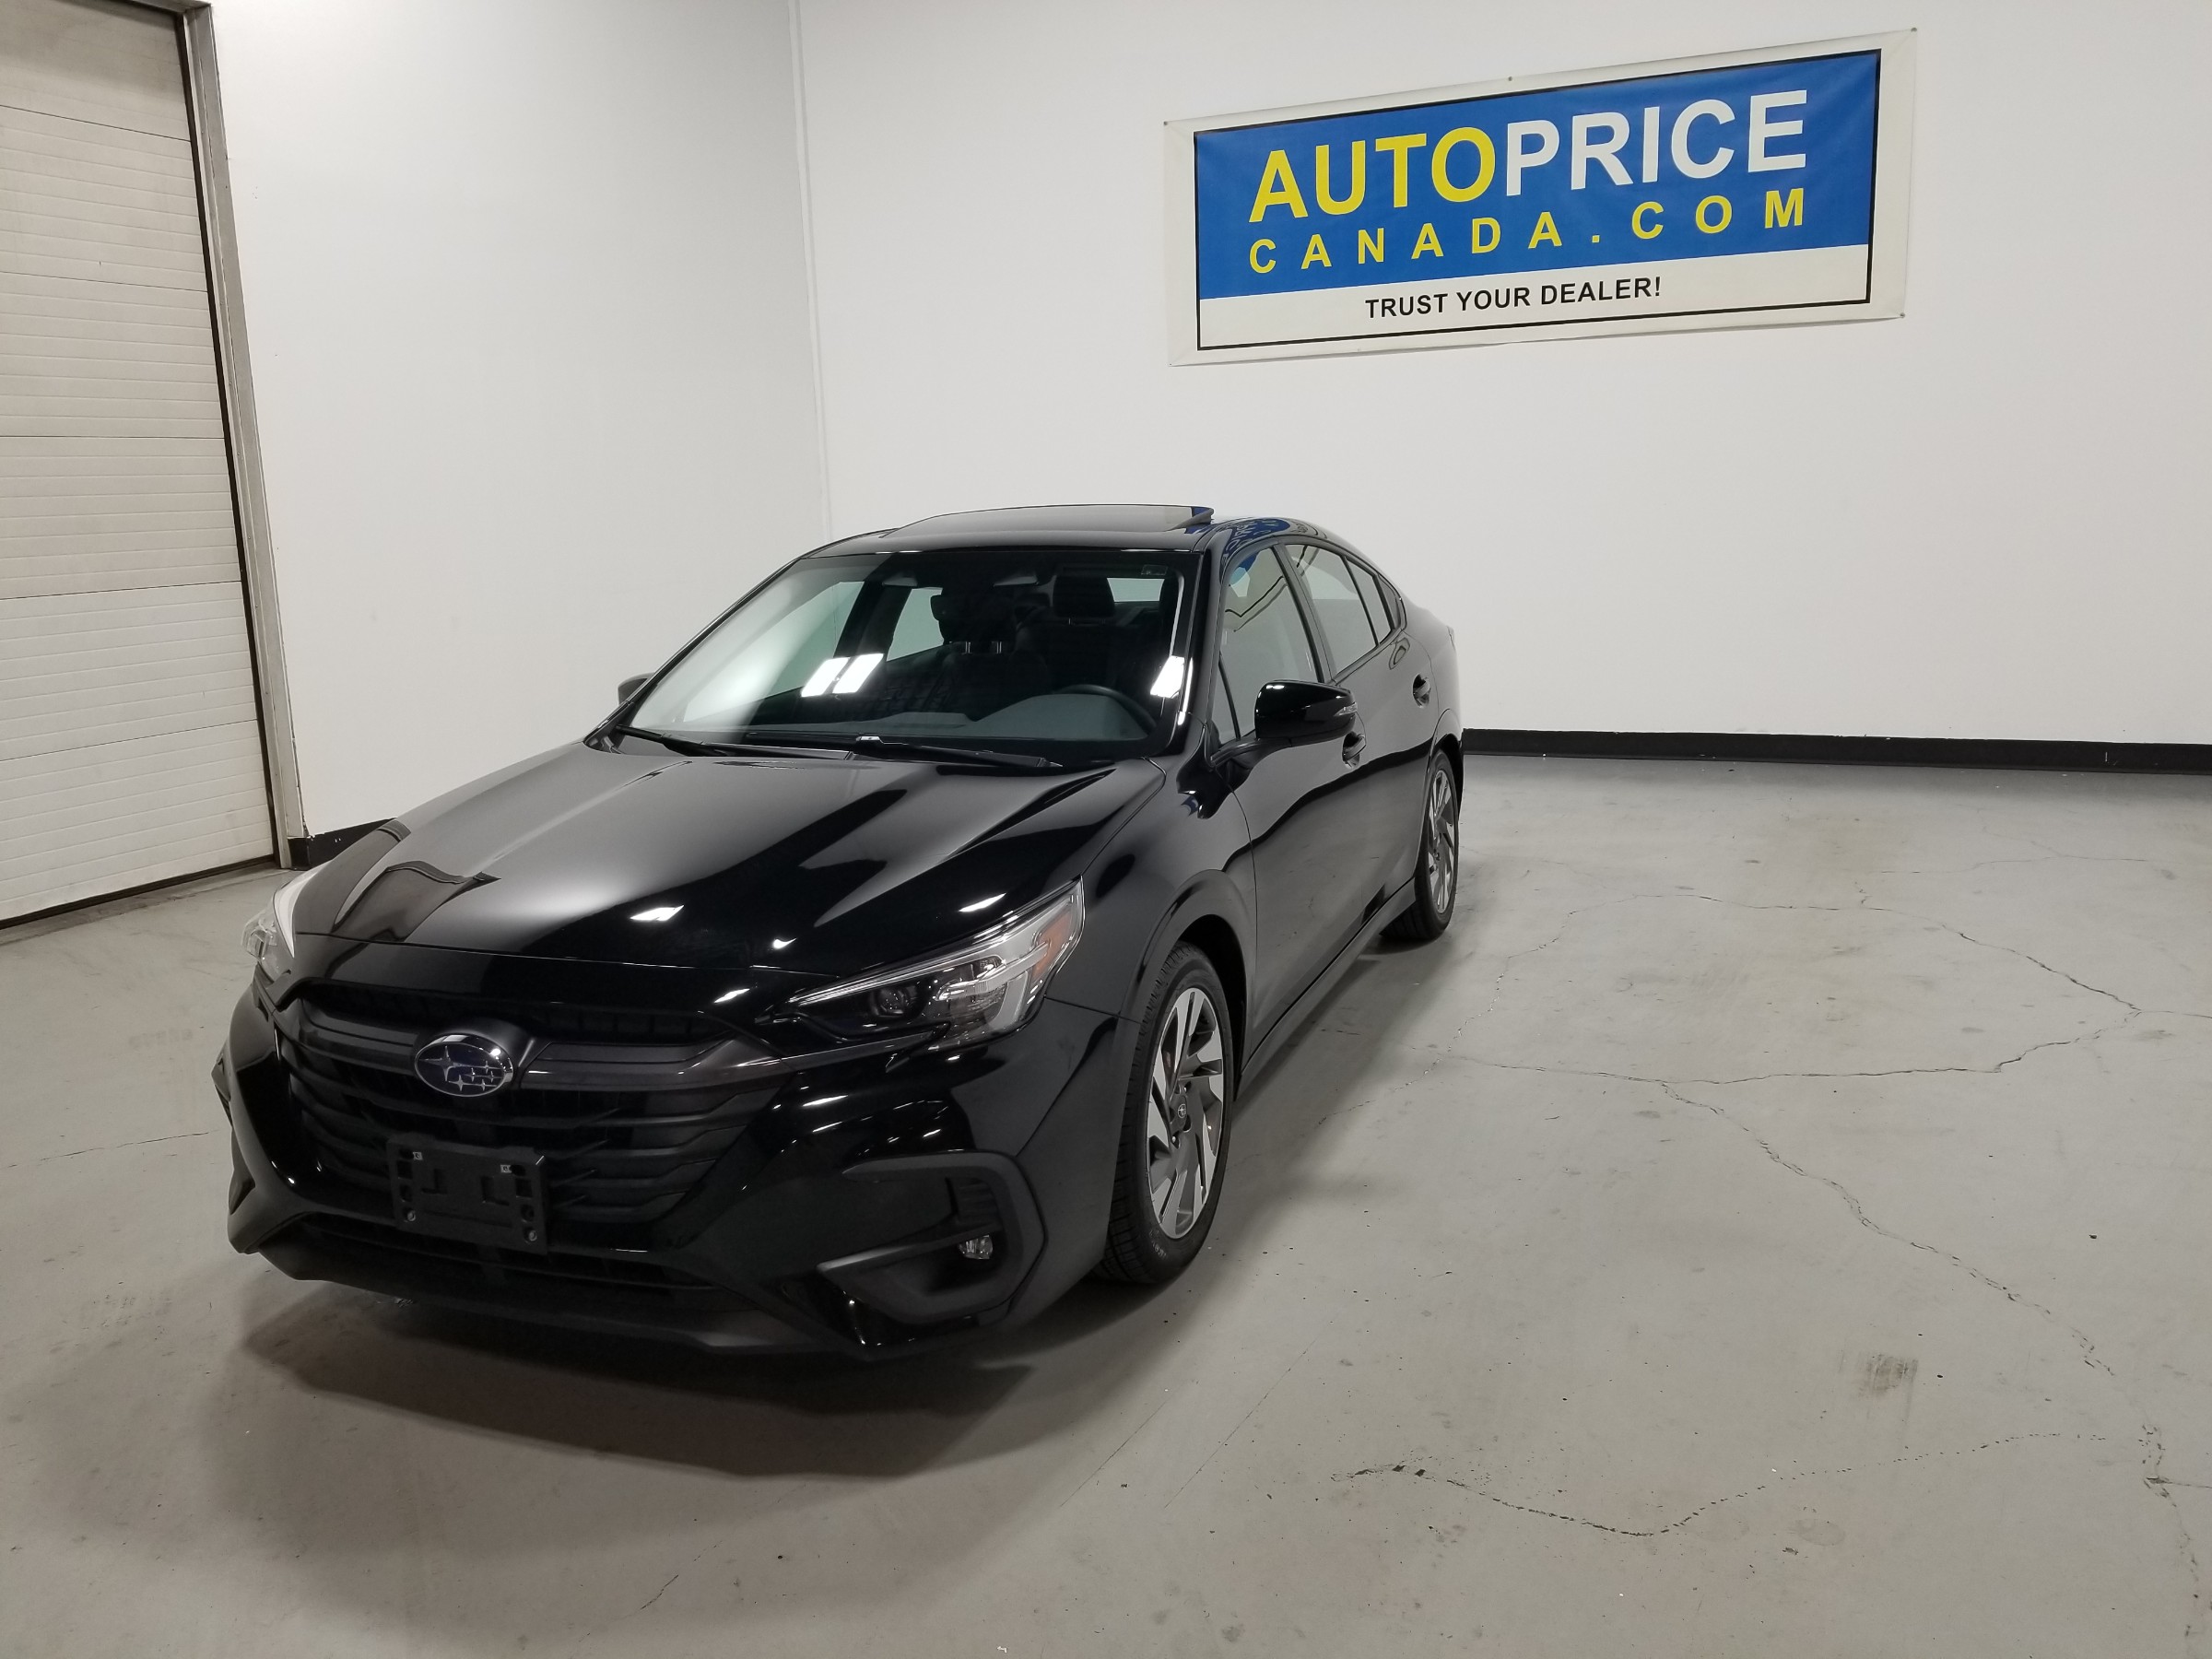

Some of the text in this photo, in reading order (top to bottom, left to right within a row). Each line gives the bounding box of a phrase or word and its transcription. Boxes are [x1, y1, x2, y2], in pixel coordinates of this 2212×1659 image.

[1250, 89, 1808, 222] AUTOPRICE
[1250, 189, 1805, 274] CANADA.COM
[1365, 276, 1662, 319] TRUST YOUR DEALER!
